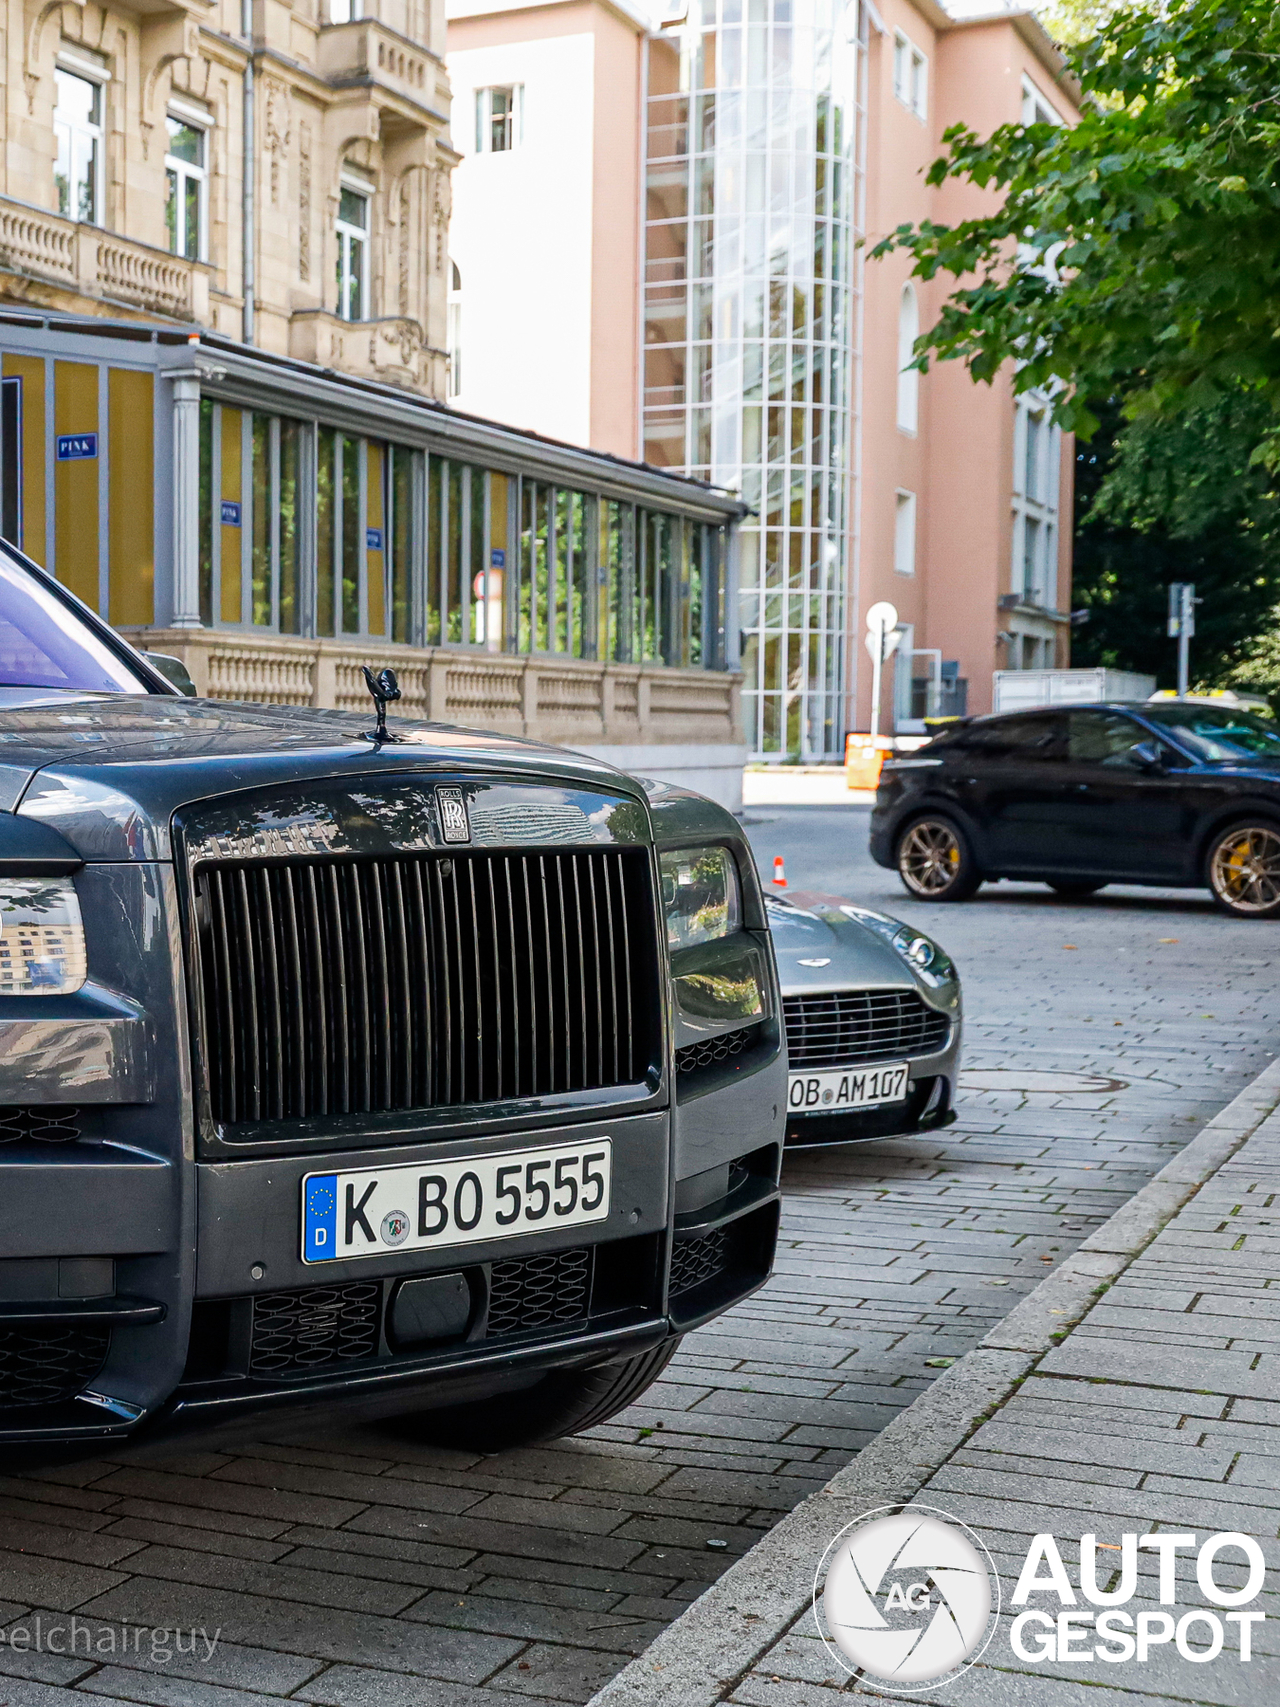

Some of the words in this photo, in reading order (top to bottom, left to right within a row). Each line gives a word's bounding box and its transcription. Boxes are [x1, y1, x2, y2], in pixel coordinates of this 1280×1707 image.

[60, 439, 90, 452] PINK
[440, 790, 461, 798] ROLLS
[790, 1079, 820, 1107] OB
[344, 1180, 378, 1245] K
[417, 1171, 483, 1237] BO
[495, 1151, 605, 1226] 5555
[314, 1227, 327, 1246] D
